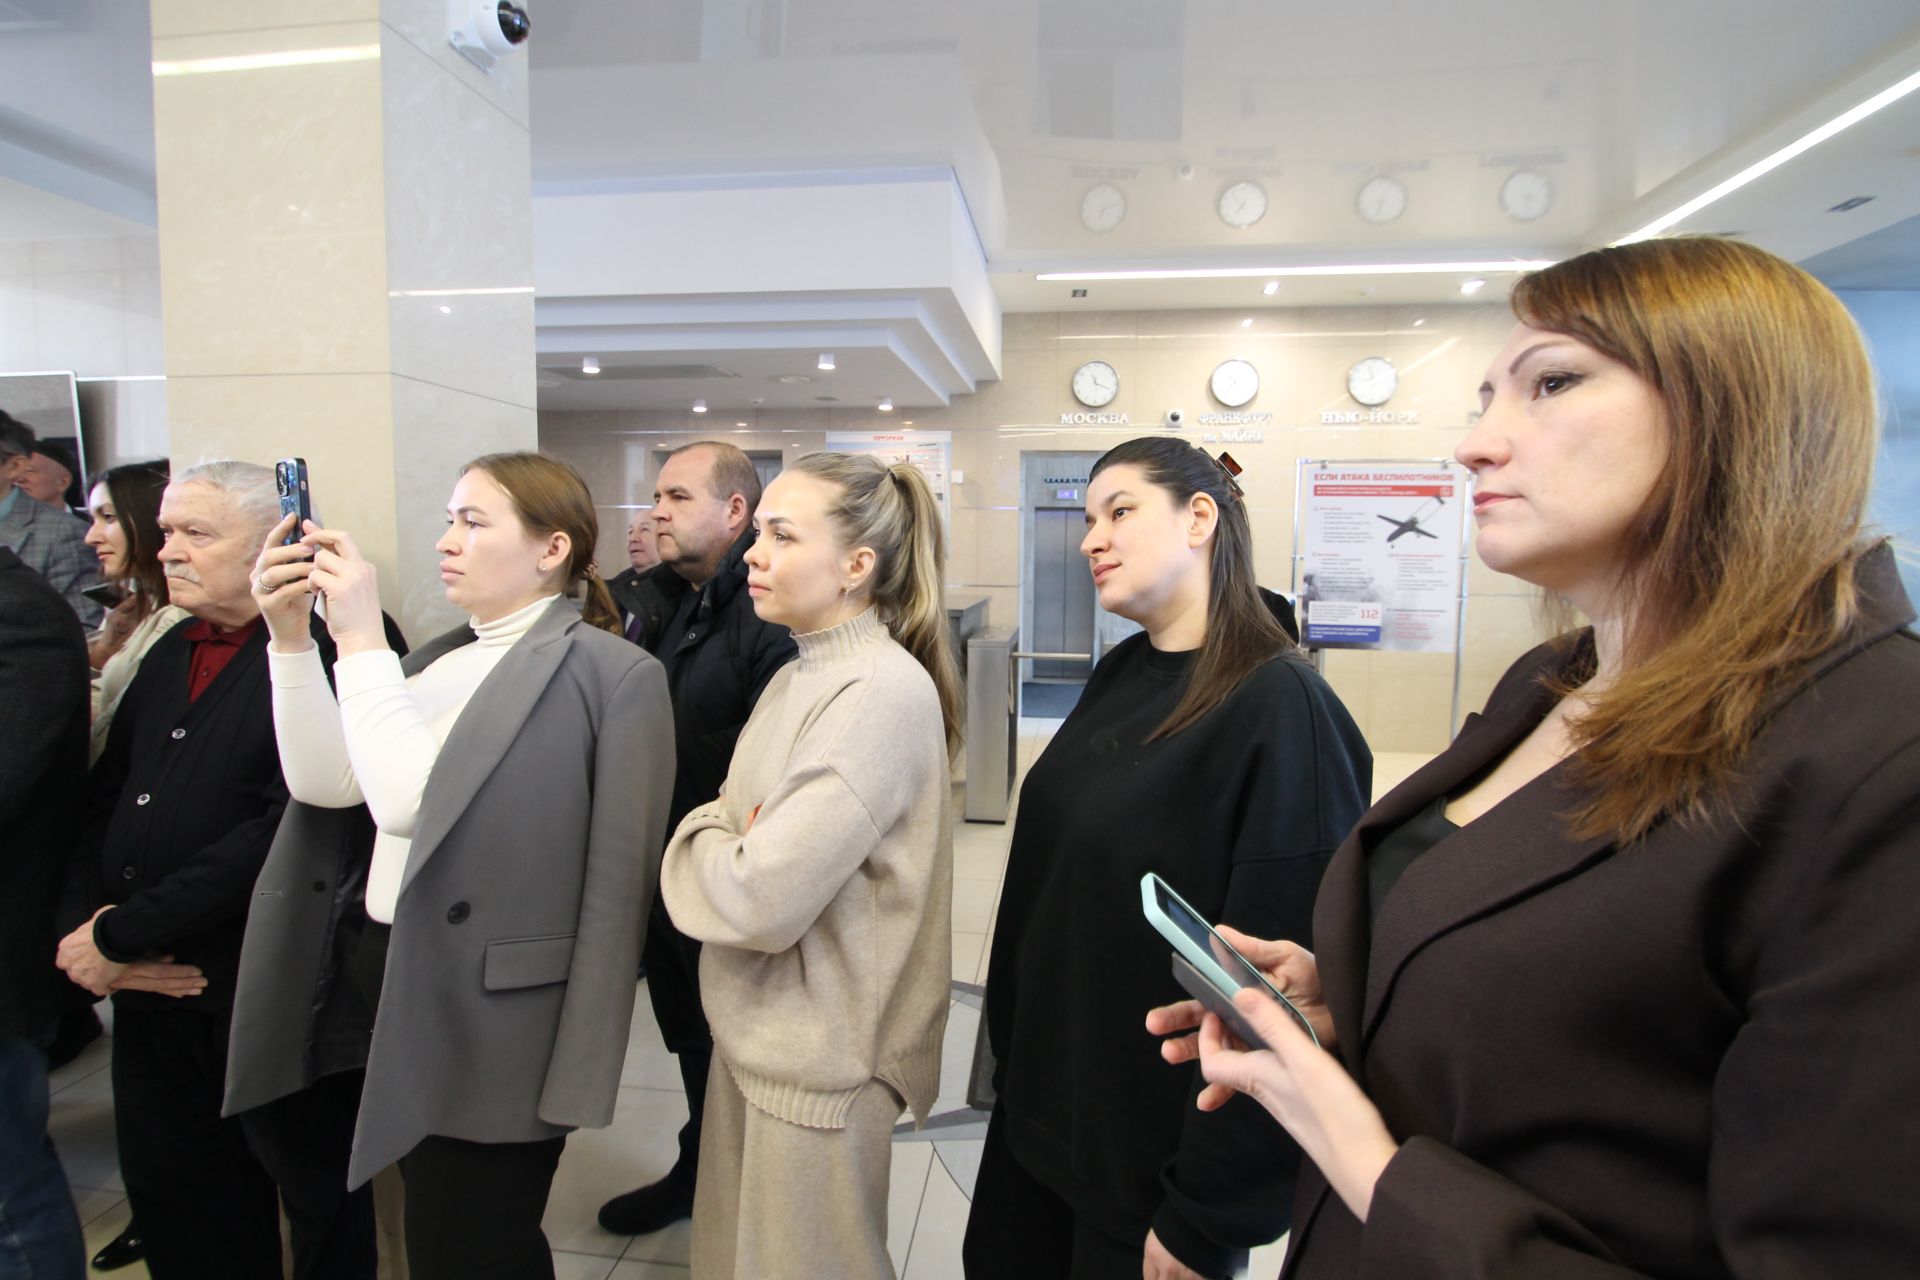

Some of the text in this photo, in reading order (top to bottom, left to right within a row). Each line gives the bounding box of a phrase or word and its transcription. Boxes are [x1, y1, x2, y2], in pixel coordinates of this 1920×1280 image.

[1060, 412, 1129, 425] МОСКВА
[1321, 407, 1420, 425] НЬЮ-ЙОРК
[1314, 473, 1454, 481] ЕСЛИ АТАКА БЕСПИЛОТНИКОВ
[1361, 609, 1379, 619] 112
